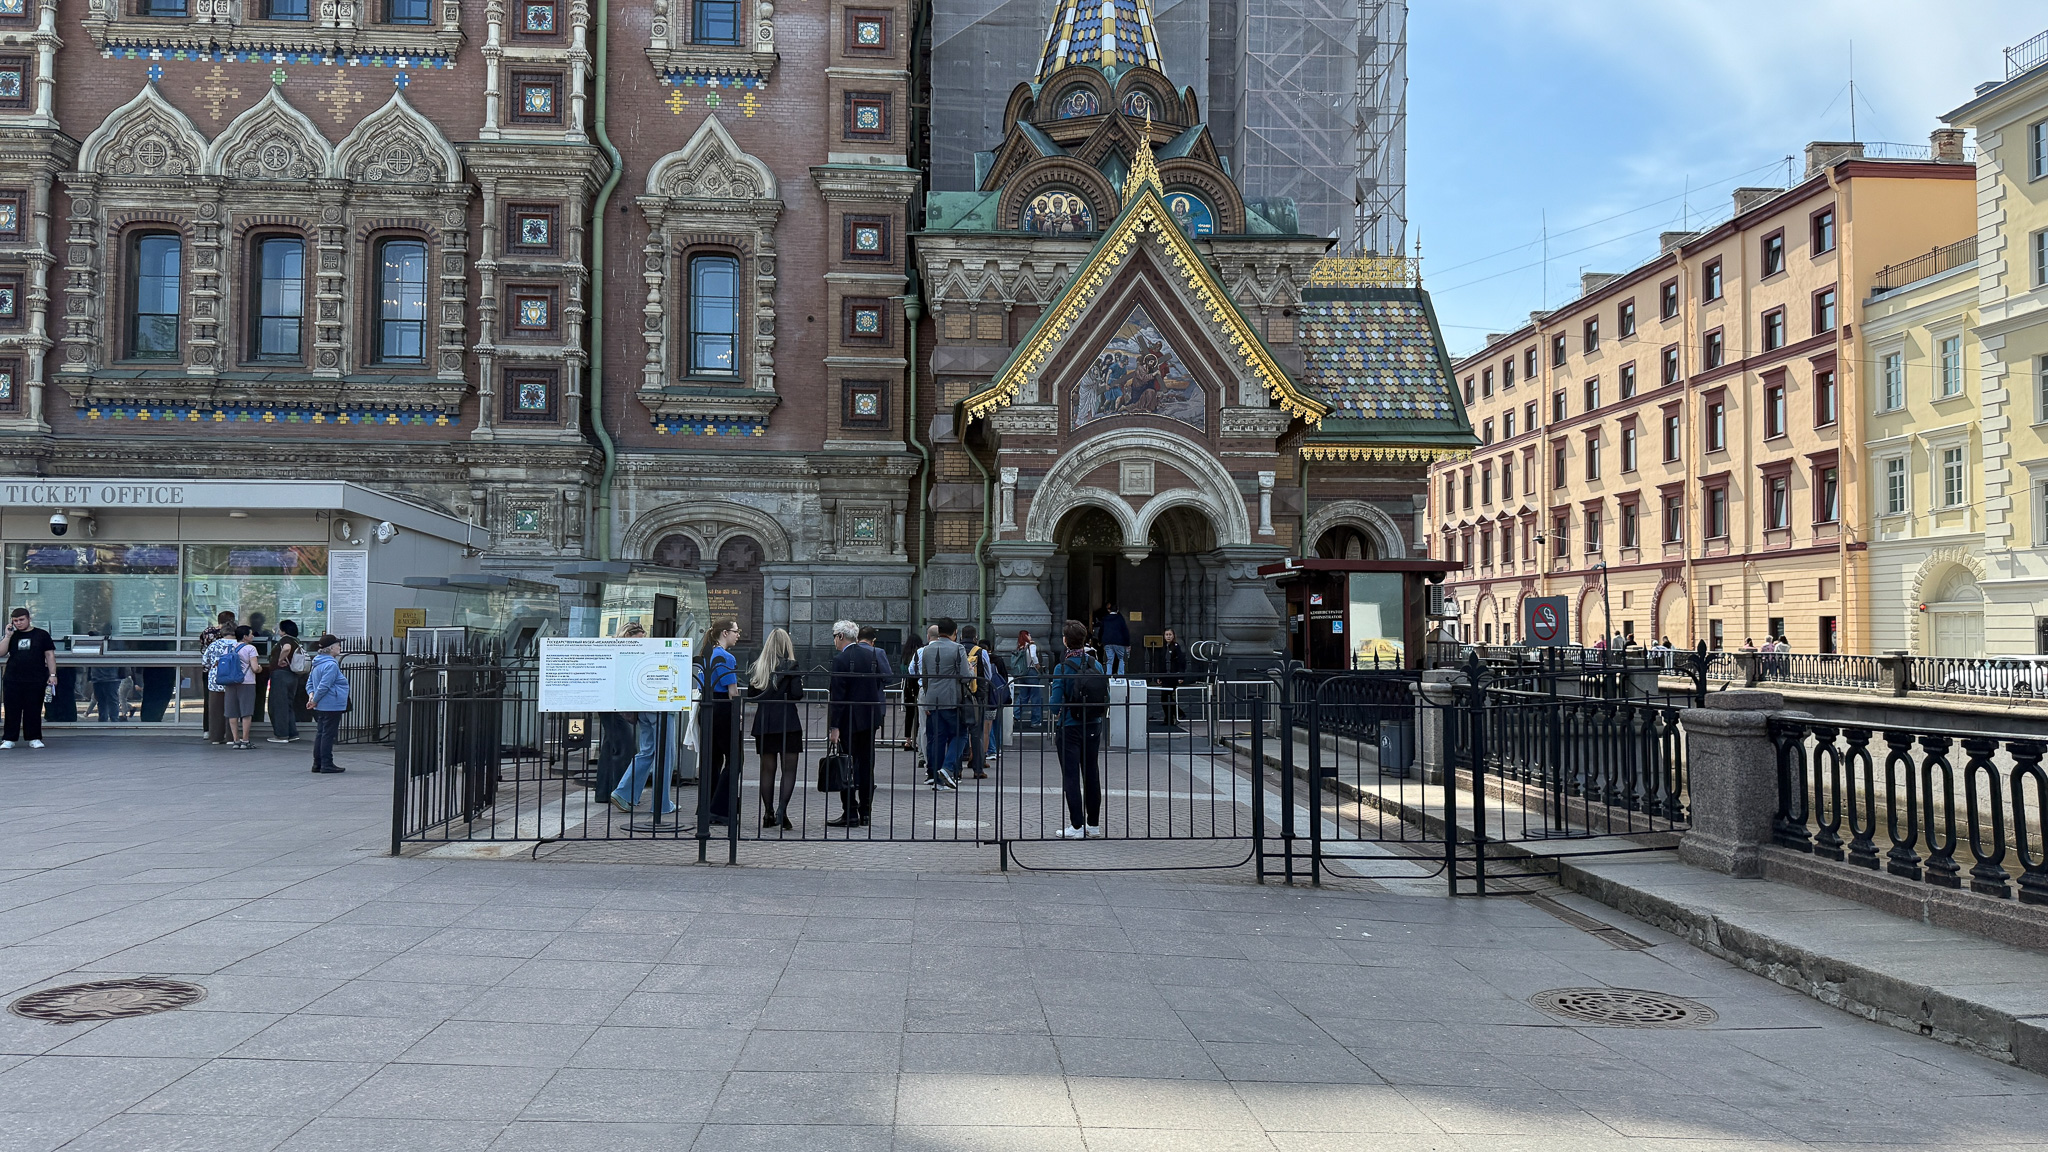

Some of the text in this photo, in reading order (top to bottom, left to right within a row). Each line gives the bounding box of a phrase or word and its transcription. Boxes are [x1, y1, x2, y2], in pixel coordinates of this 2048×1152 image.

[6, 485, 184, 504] TICKET OFFICE
[23, 581, 30, 591] 2
[202, 583, 209, 593] 3
